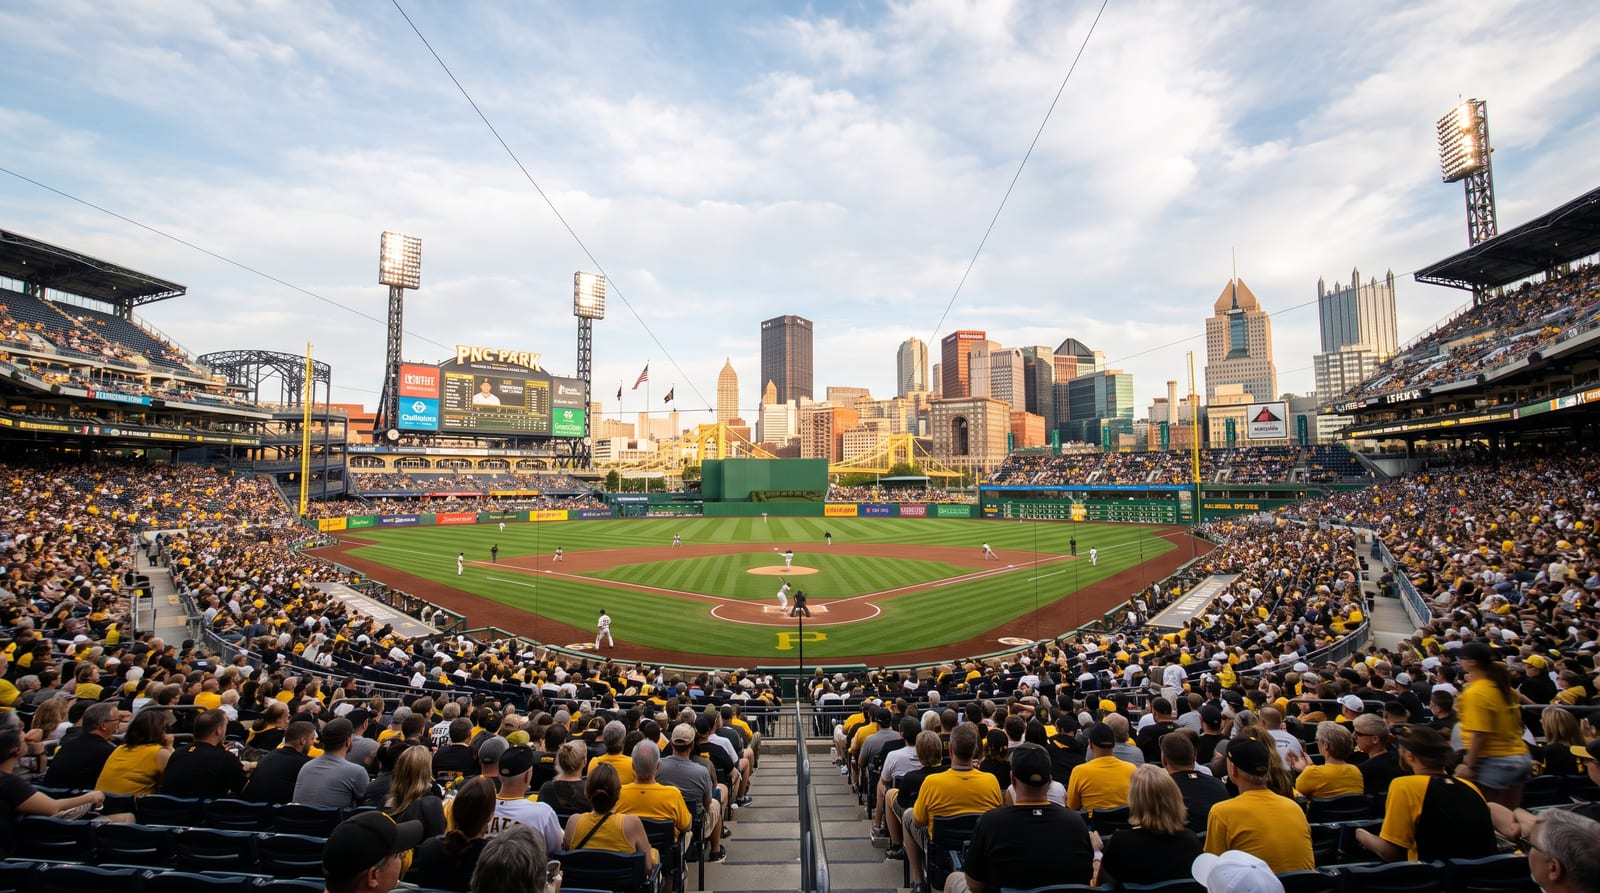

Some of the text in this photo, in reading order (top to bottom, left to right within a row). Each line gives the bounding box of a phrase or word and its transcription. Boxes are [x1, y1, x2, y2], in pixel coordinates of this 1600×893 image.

[456, 344, 494, 365] PNC
[498, 350, 542, 372] PARK
[775, 631, 828, 650] P
